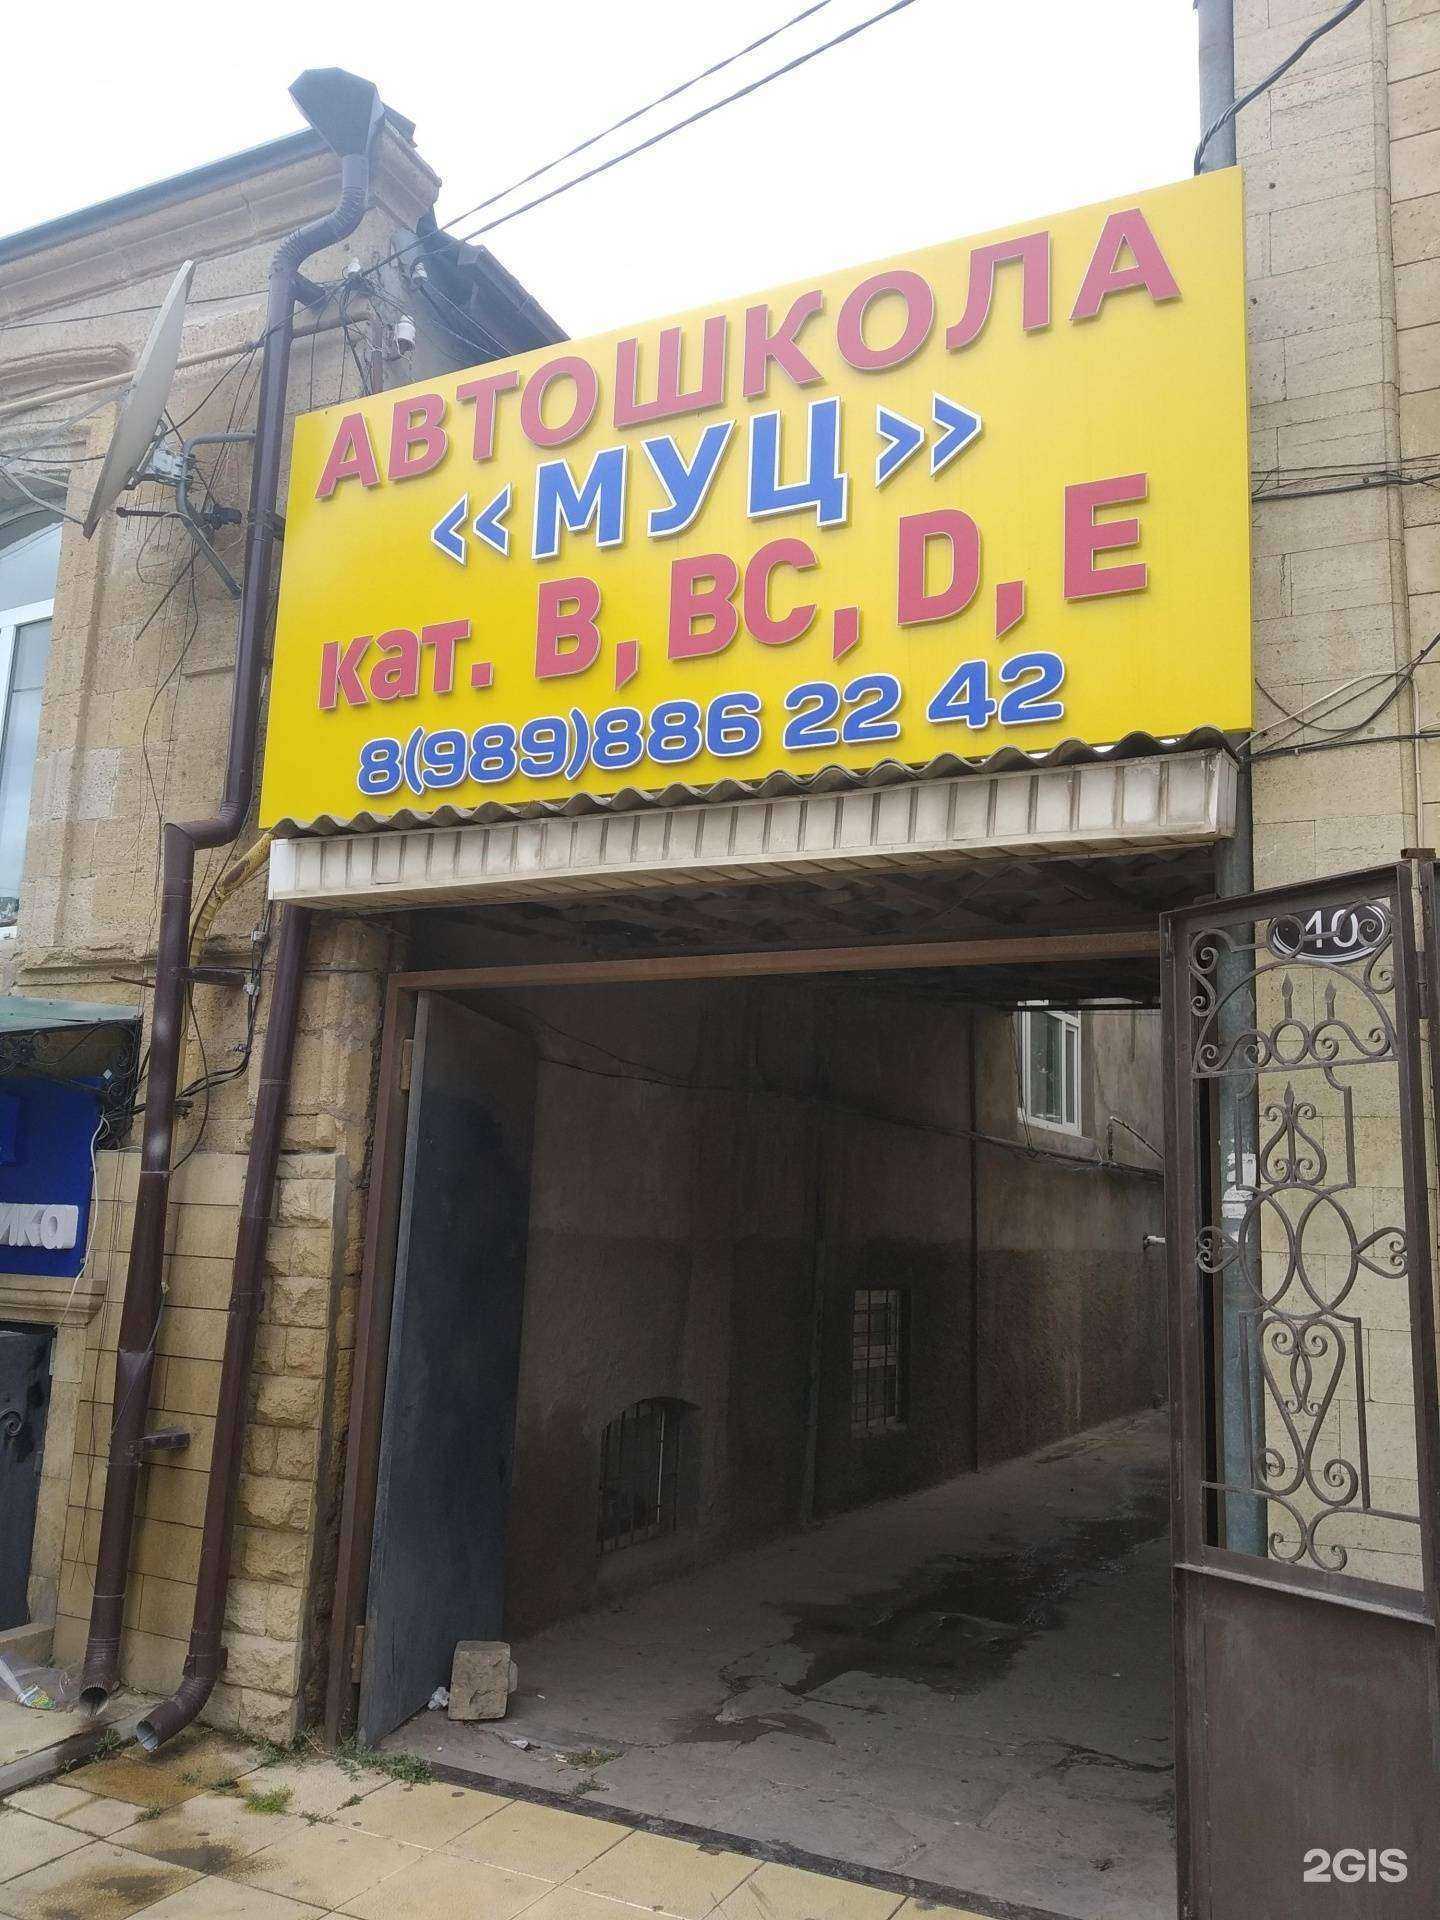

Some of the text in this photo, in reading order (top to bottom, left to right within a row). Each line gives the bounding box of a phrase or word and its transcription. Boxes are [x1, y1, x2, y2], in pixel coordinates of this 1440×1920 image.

[314, 207, 1182, 498] АВТОШКОЛА
[318, 619, 493, 709] кат.
[897, 508, 1025, 640] D,
[357, 651, 1065, 796] 8(989)886 22 42
